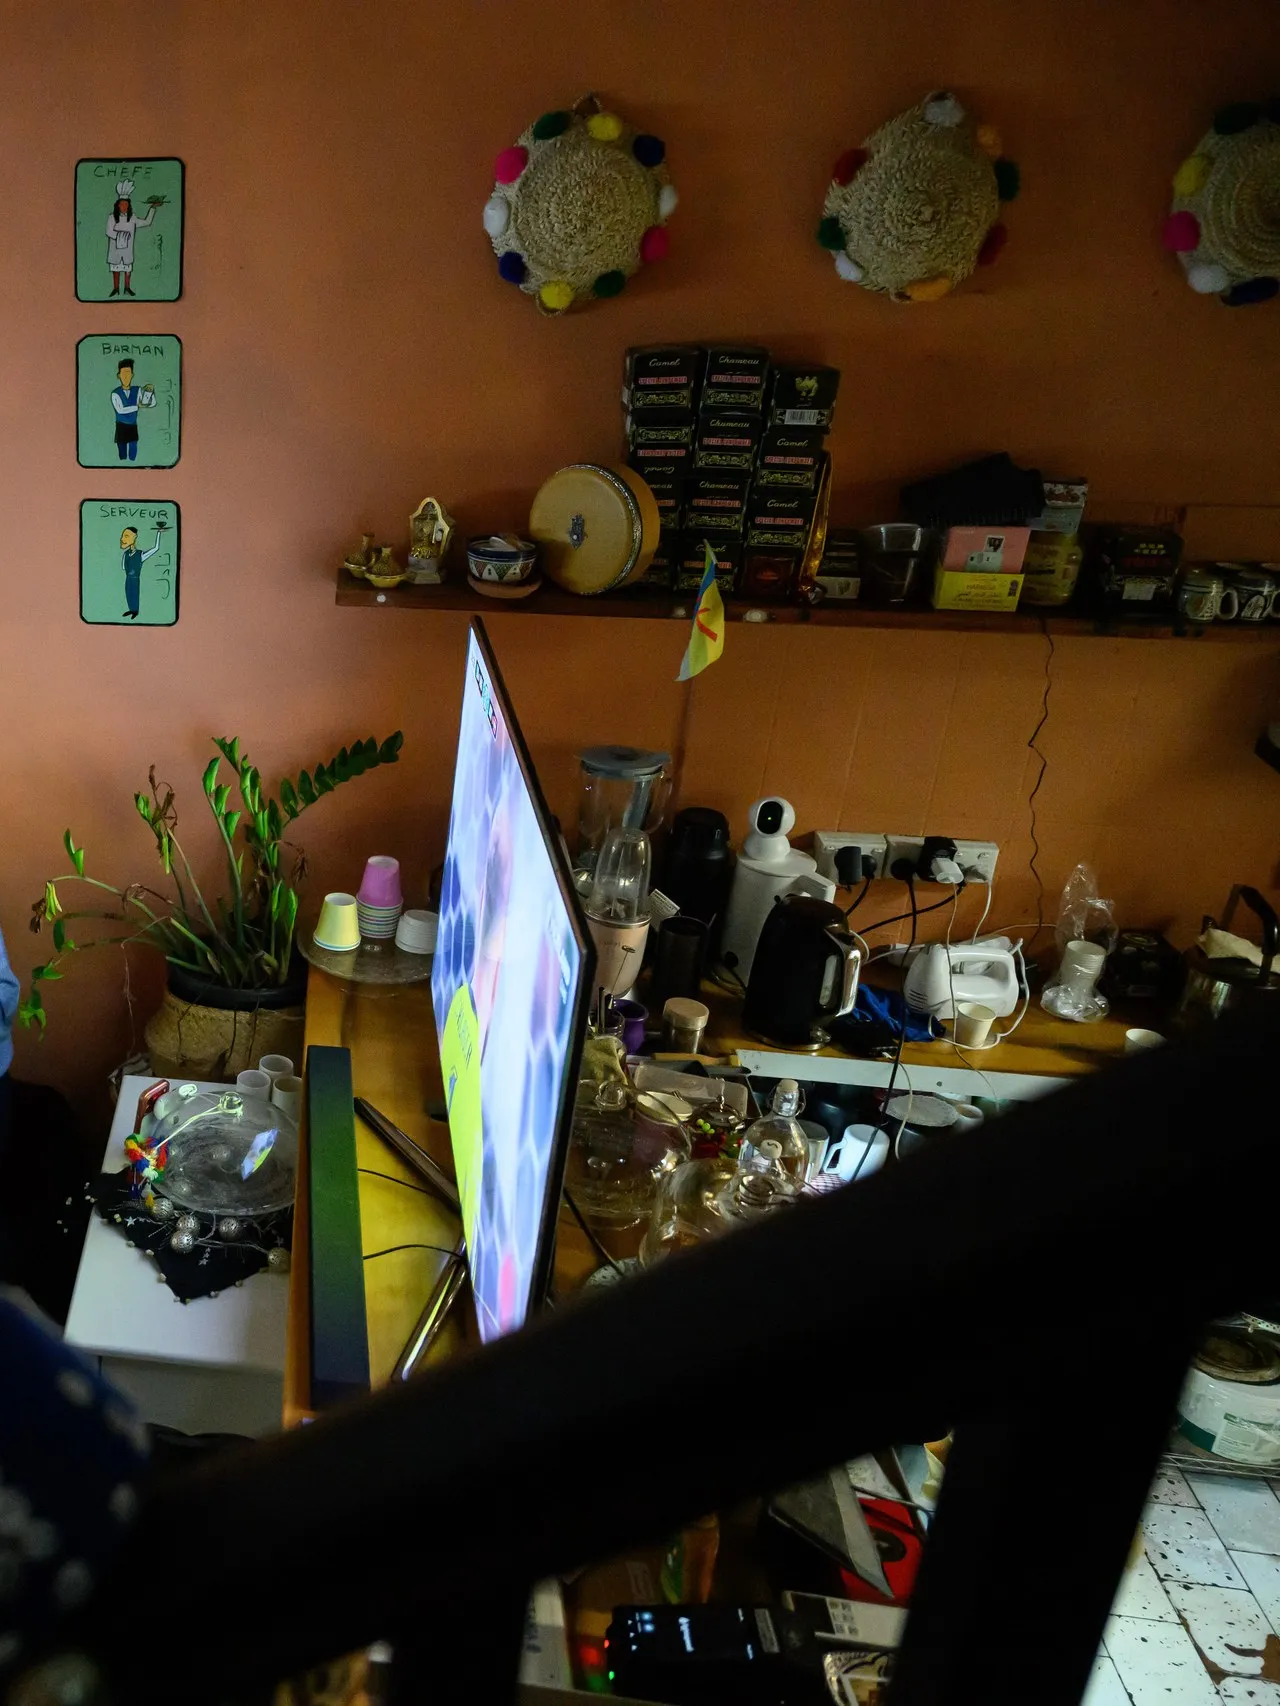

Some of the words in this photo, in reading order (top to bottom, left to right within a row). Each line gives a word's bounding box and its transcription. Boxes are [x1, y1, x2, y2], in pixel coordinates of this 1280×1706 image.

[102, 343, 164, 357] BARMAN
[648, 358, 681, 367] Camel
[718, 355, 760, 365] Chameau
[776, 437, 808, 448] Camel
[766, 499, 799, 509] Camel
[100, 505, 169, 519] SERVEUR
